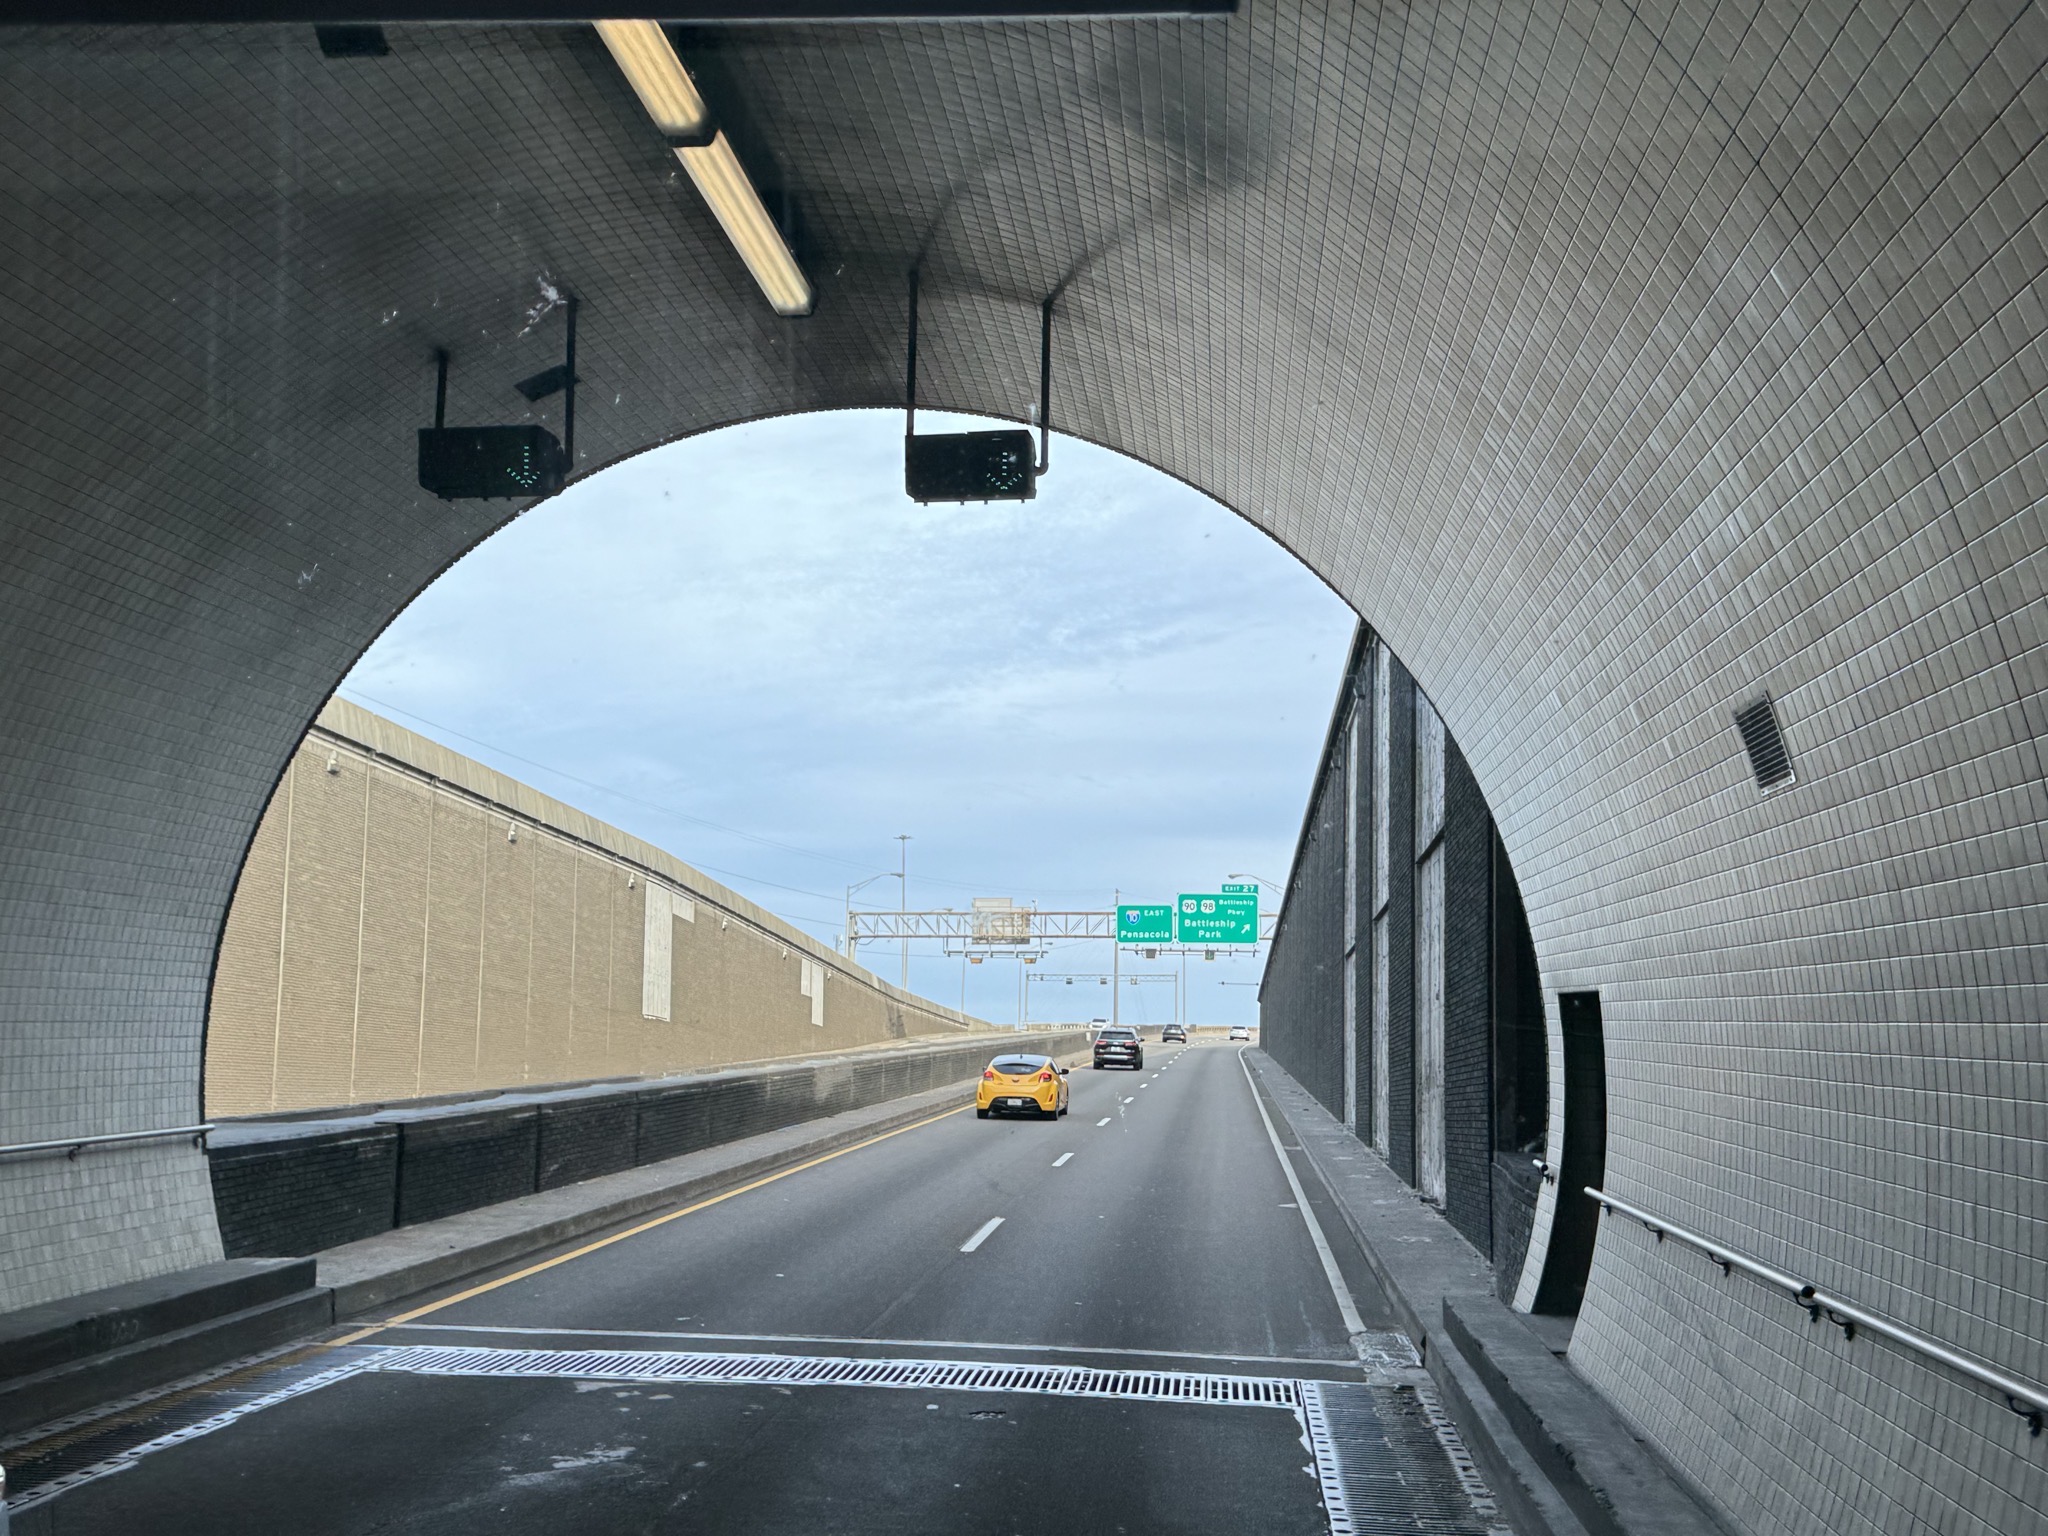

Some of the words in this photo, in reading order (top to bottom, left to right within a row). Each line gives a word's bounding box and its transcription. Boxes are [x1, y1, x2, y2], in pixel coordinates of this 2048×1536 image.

[1184, 902, 1196, 911] 90
[1202, 902, 1214, 911] 98
[1129, 913, 1139, 923] 10
[1144, 909, 1164, 917] EAST
[1184, 919, 1236, 929] Battleship
[1120, 930, 1170, 939] Pensacola
[1198, 930, 1222, 938] Park
